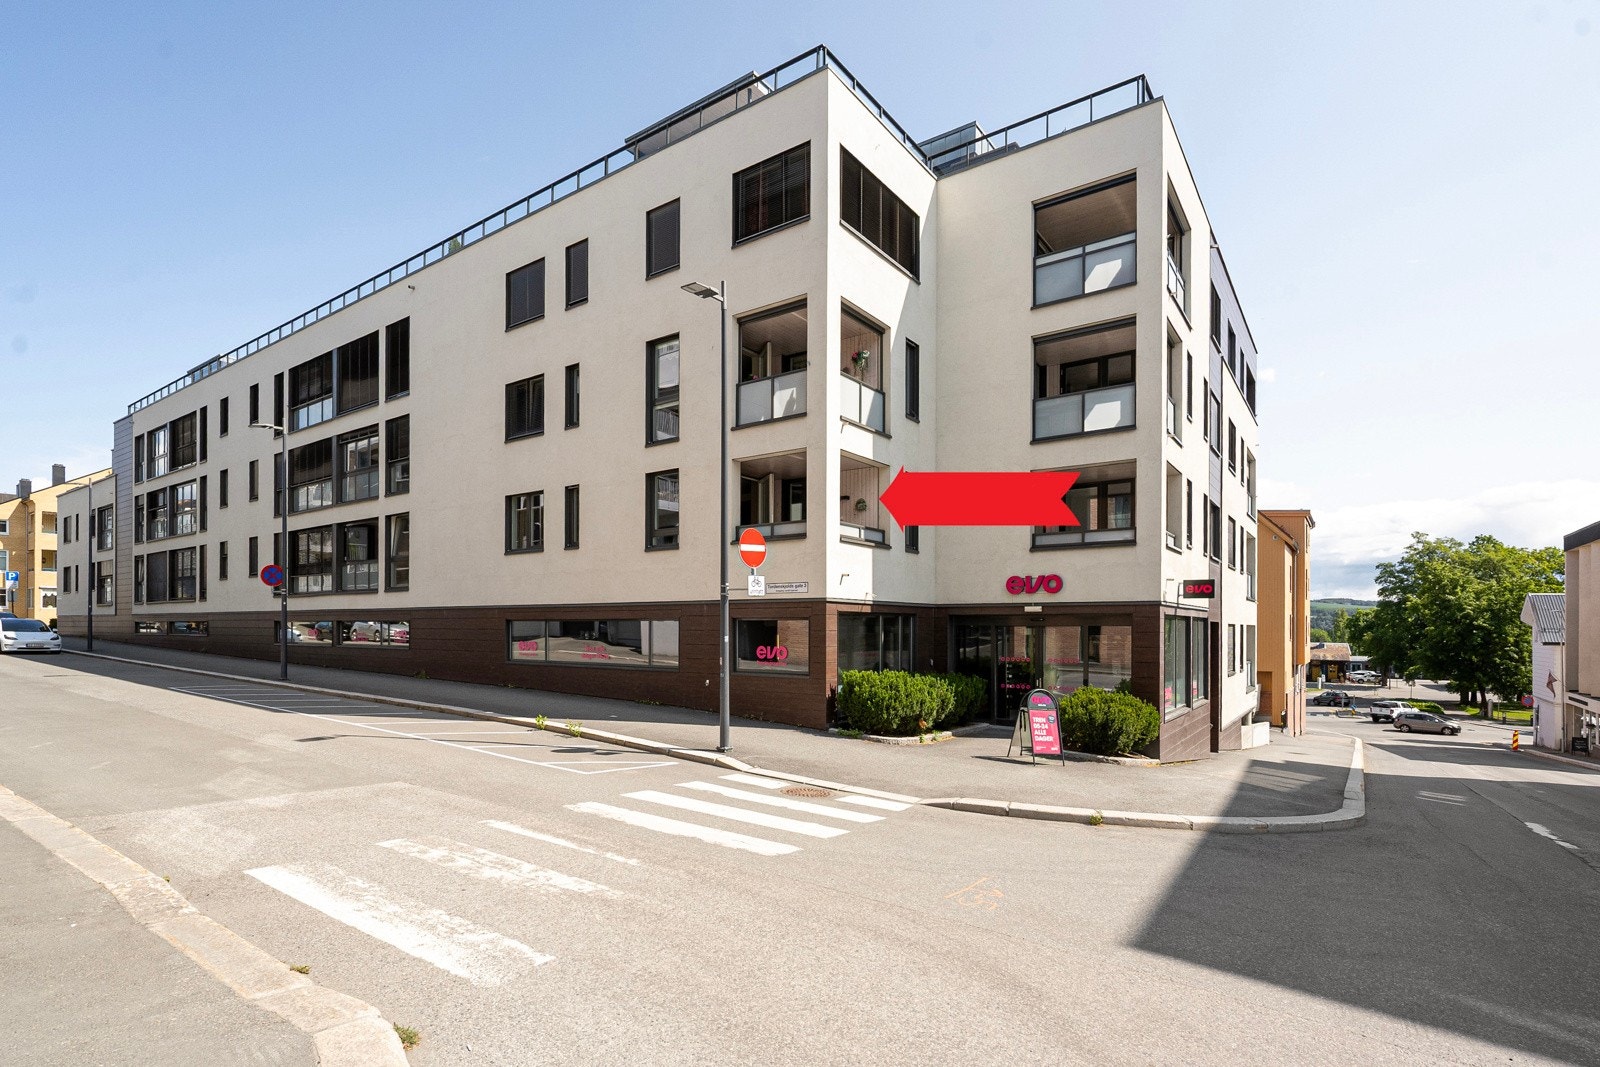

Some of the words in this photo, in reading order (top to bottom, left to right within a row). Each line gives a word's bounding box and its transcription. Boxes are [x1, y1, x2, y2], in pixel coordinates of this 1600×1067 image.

[8, 572, 16, 580] P
[1005, 574, 1063, 595] evo
[1185, 583, 1213, 594] evo
[756, 645, 789, 660] evo
